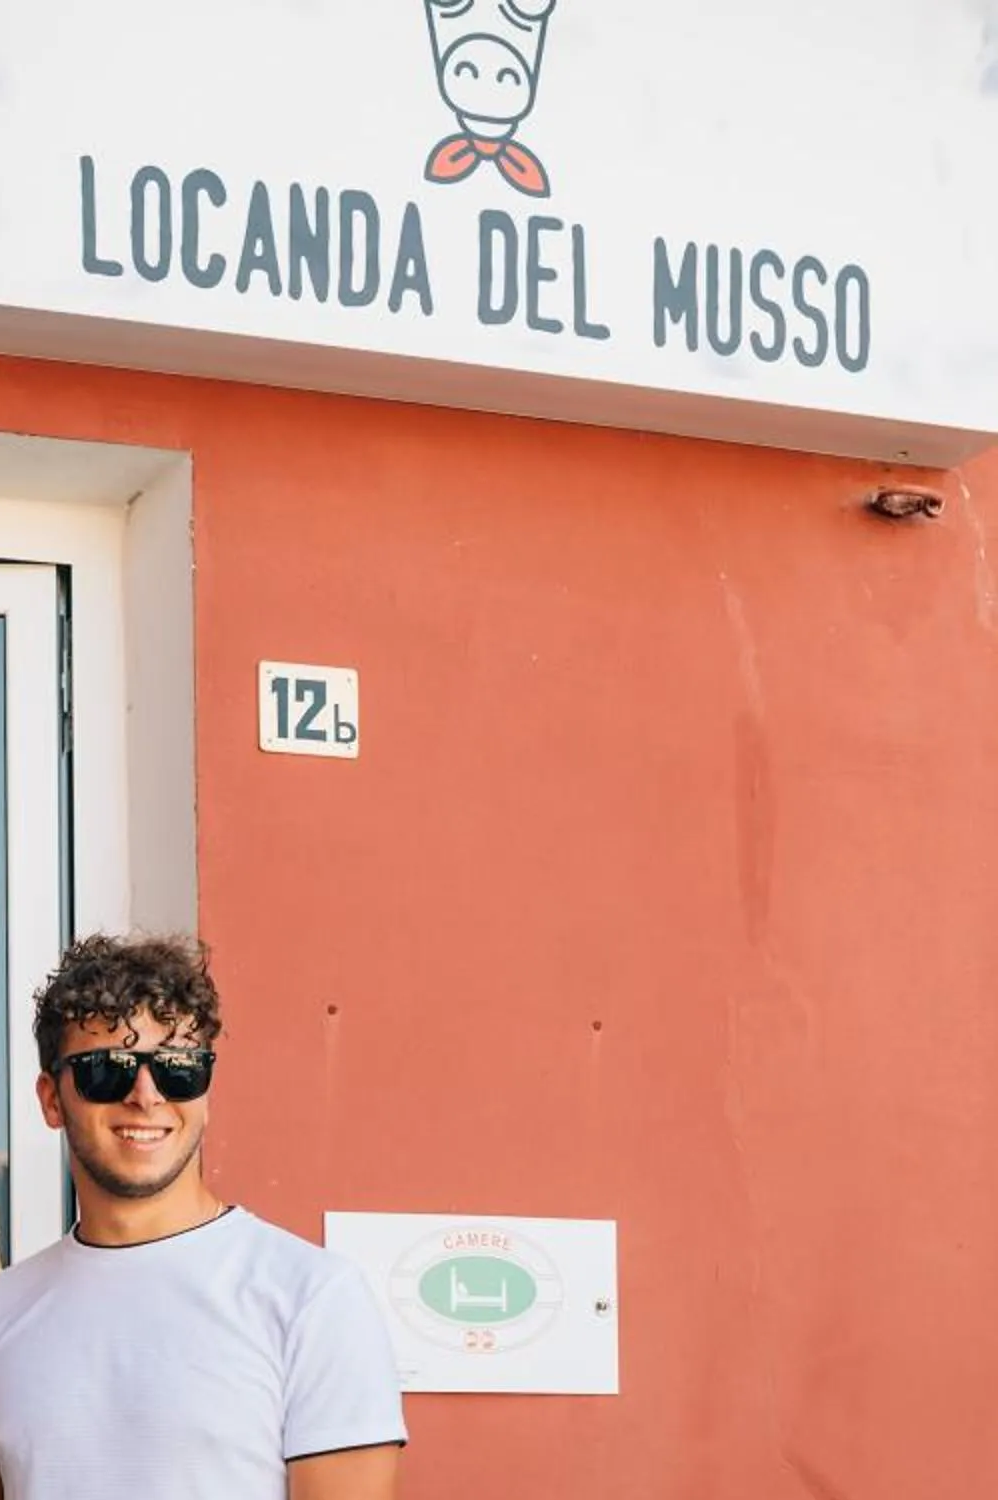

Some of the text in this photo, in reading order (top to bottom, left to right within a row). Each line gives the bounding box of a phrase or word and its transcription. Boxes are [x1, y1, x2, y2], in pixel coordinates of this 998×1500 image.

[79, 155, 871, 373] LOCANDA DEL MUSSO
[442, 1231, 513, 1251] CAMERE
